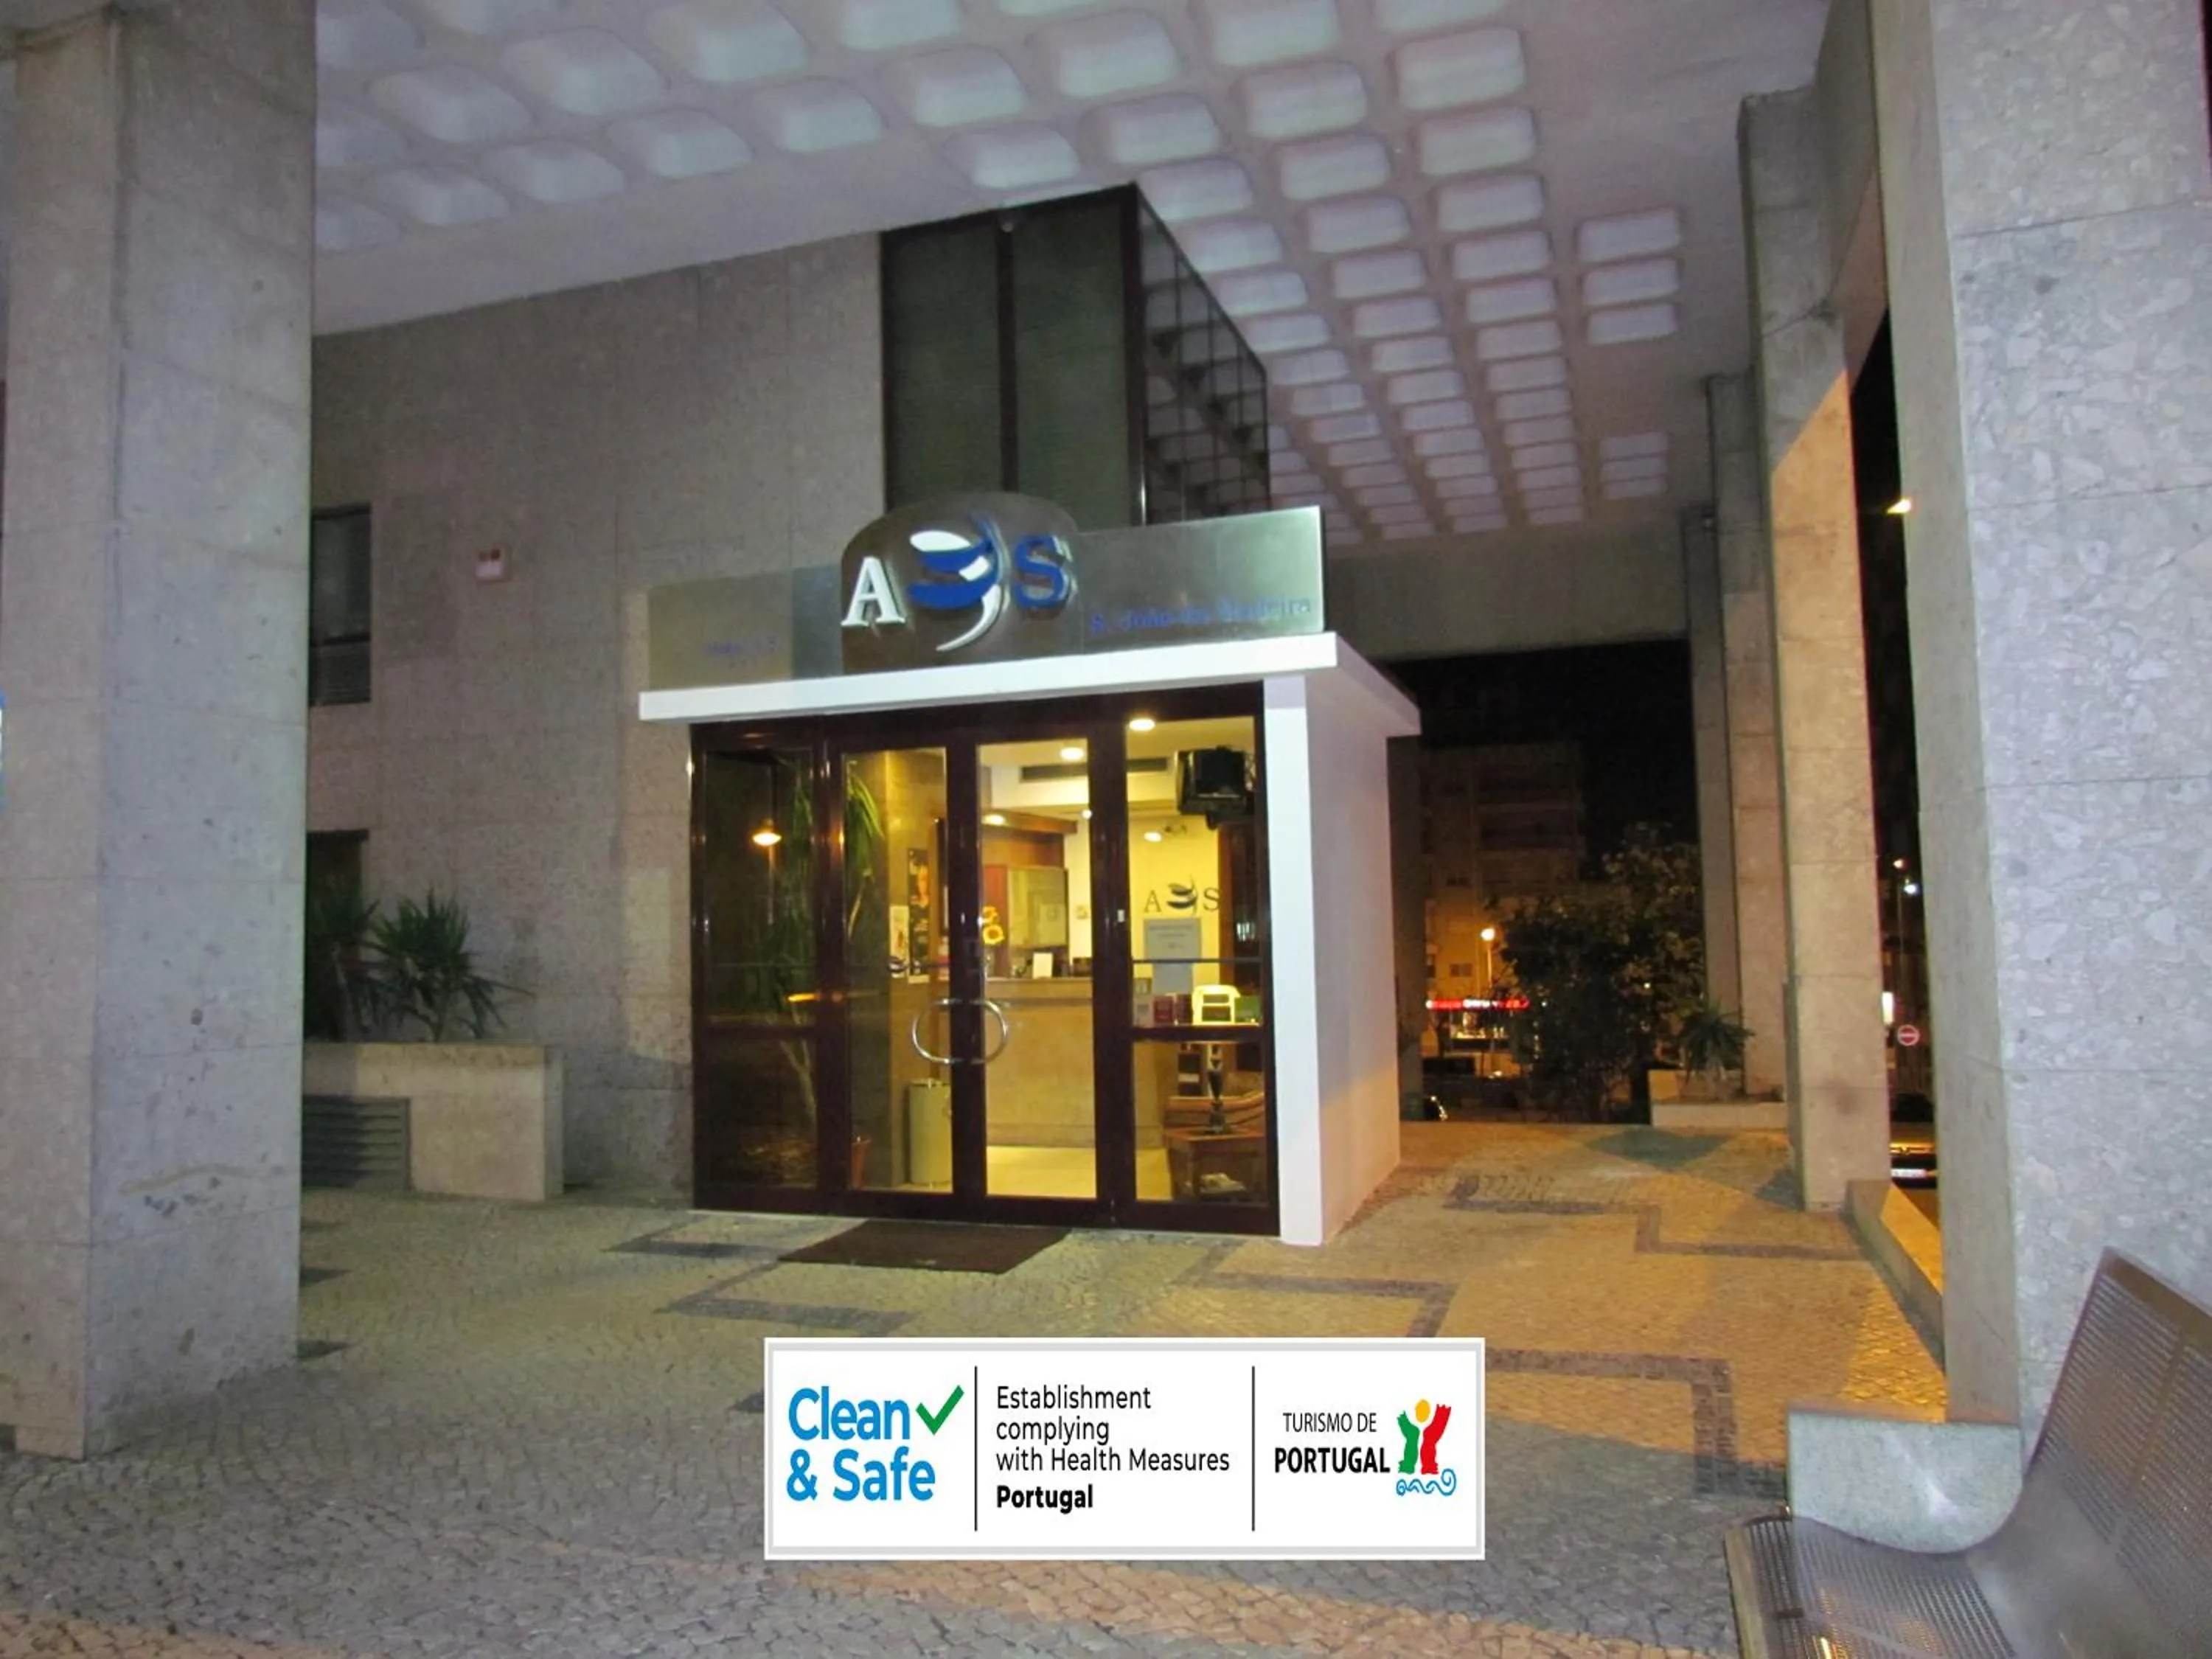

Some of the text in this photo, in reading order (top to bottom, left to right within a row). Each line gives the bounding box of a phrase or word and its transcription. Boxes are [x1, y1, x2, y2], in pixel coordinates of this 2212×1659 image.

[841, 534, 1074, 627] A S
[1144, 887, 1222, 913] A S
